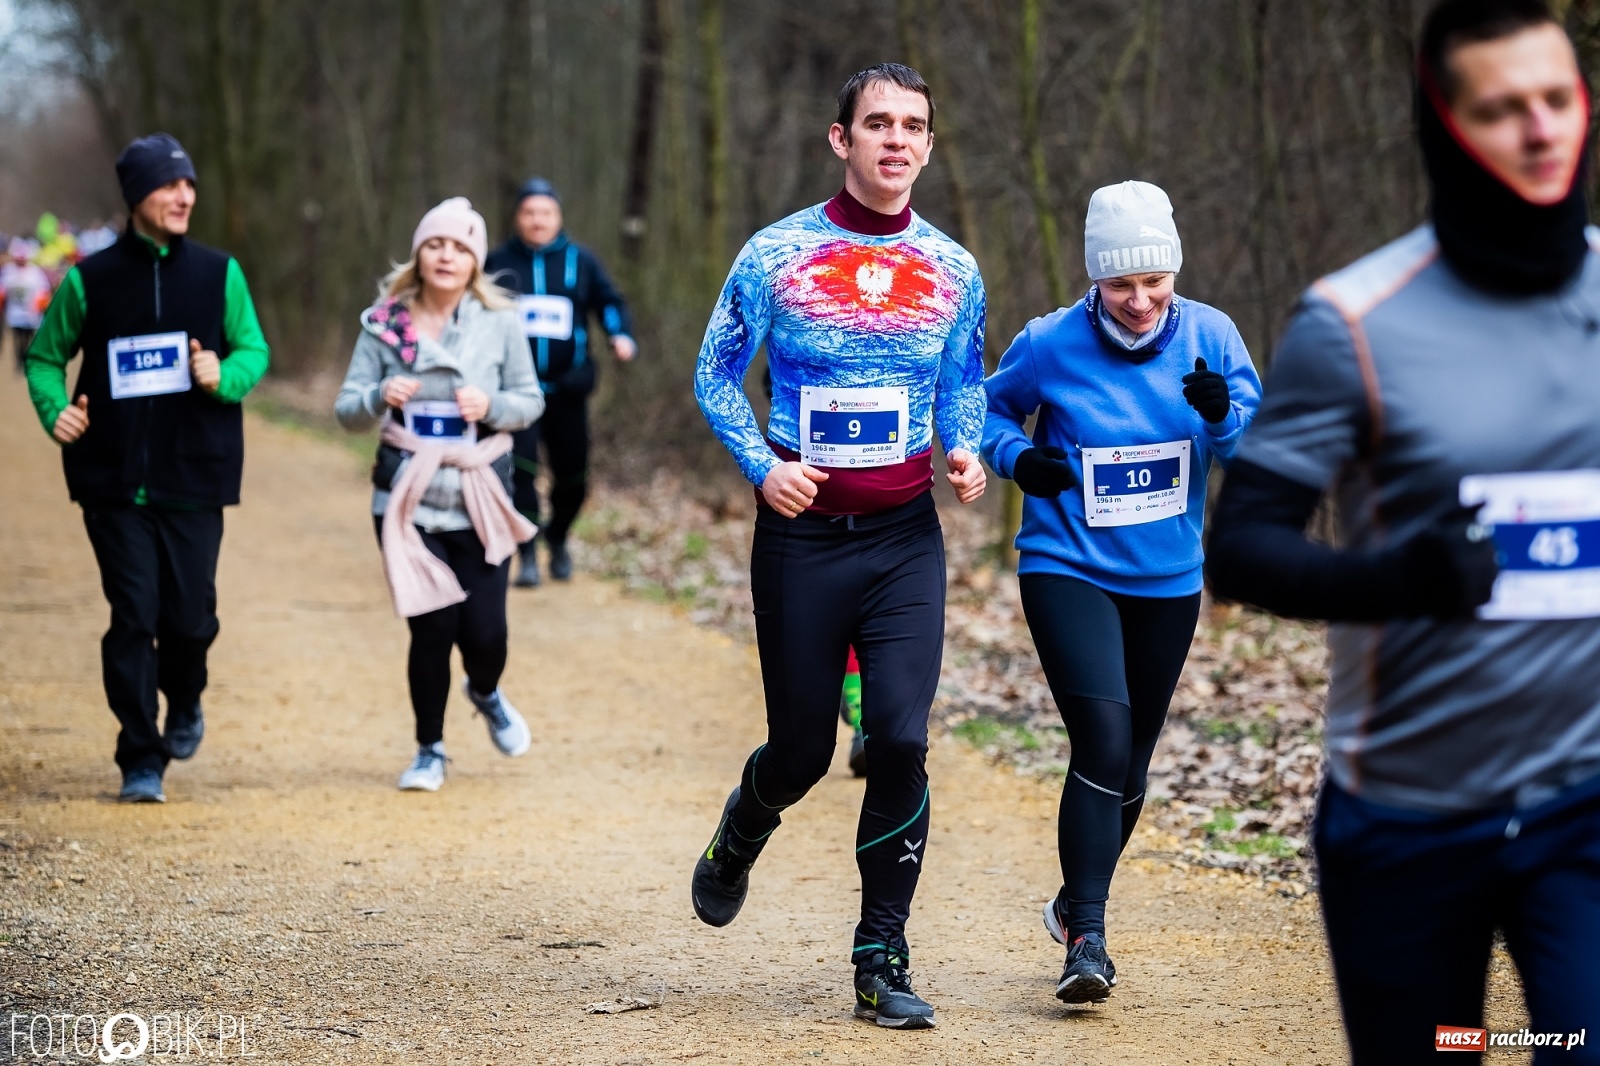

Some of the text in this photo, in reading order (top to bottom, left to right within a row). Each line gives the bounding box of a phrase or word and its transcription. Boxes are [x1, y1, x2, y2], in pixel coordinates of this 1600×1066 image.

[1098, 244, 1172, 272] PUMA
[135, 350, 163, 370] 104
[432, 419, 444, 435] 8
[848, 419, 861, 438] 9
[1126, 468, 1151, 489] 10
[1528, 526, 1579, 567] 45
